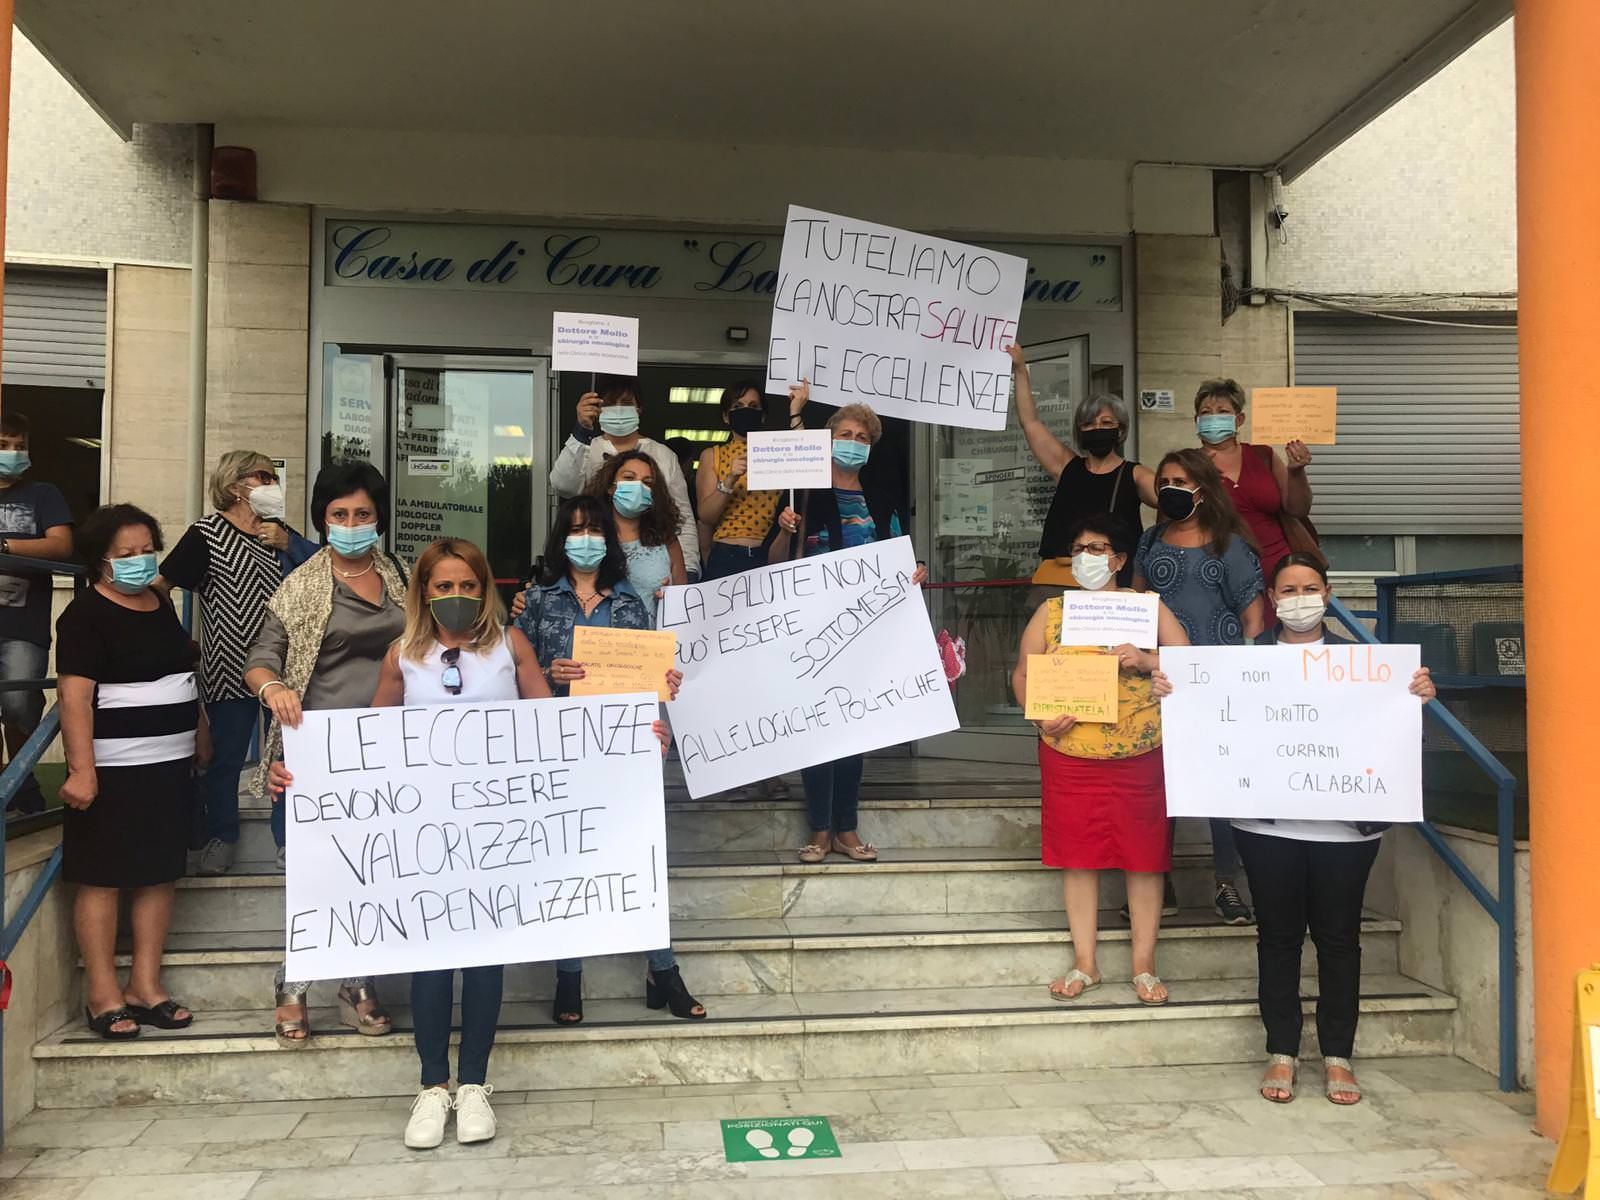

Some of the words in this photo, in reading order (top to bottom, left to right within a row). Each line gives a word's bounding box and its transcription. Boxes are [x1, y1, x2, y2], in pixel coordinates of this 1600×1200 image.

[333, 227, 455, 280] Casa
[466, 240, 526, 284] di
[544, 235, 664, 289] Cura
[791, 219, 1000, 295] TUTELIAMO
[600, 328, 629, 338] Mollo
[921, 300, 1017, 351] SALUTE
[769, 338, 787, 381] E
[796, 340, 829, 388] LE
[841, 349, 1010, 414] ECCELLENZE
[401, 521, 442, 532] DOPPLER
[409, 499, 484, 513] AMBULATORIALE
[662, 586, 706, 628] LA
[713, 564, 814, 618] SALUTE
[822, 554, 881, 590] NON
[1069, 603, 1113, 611] Dottore
[1115, 604, 1148, 613] Mollo
[718, 609, 803, 655] ESSERE
[790, 570, 910, 680] SOTTOMESSA
[1189, 663, 1211, 684] Io
[1241, 669, 1271, 683] non
[328, 713, 386, 773] LE
[400, 703, 656, 768] ECCELLENZE
[1265, 703, 1319, 722] DIRITTO
[1219, 745, 1230, 756] DI
[1276, 744, 1340, 758] CURARMI
[293, 781, 421, 823] DEVONO
[451, 769, 570, 810] ESSERE
[1239, 777, 1251, 788] IN
[332, 807, 606, 886] VALORIZZATE
[290, 909, 318, 952] E
[327, 898, 408, 947] NON
